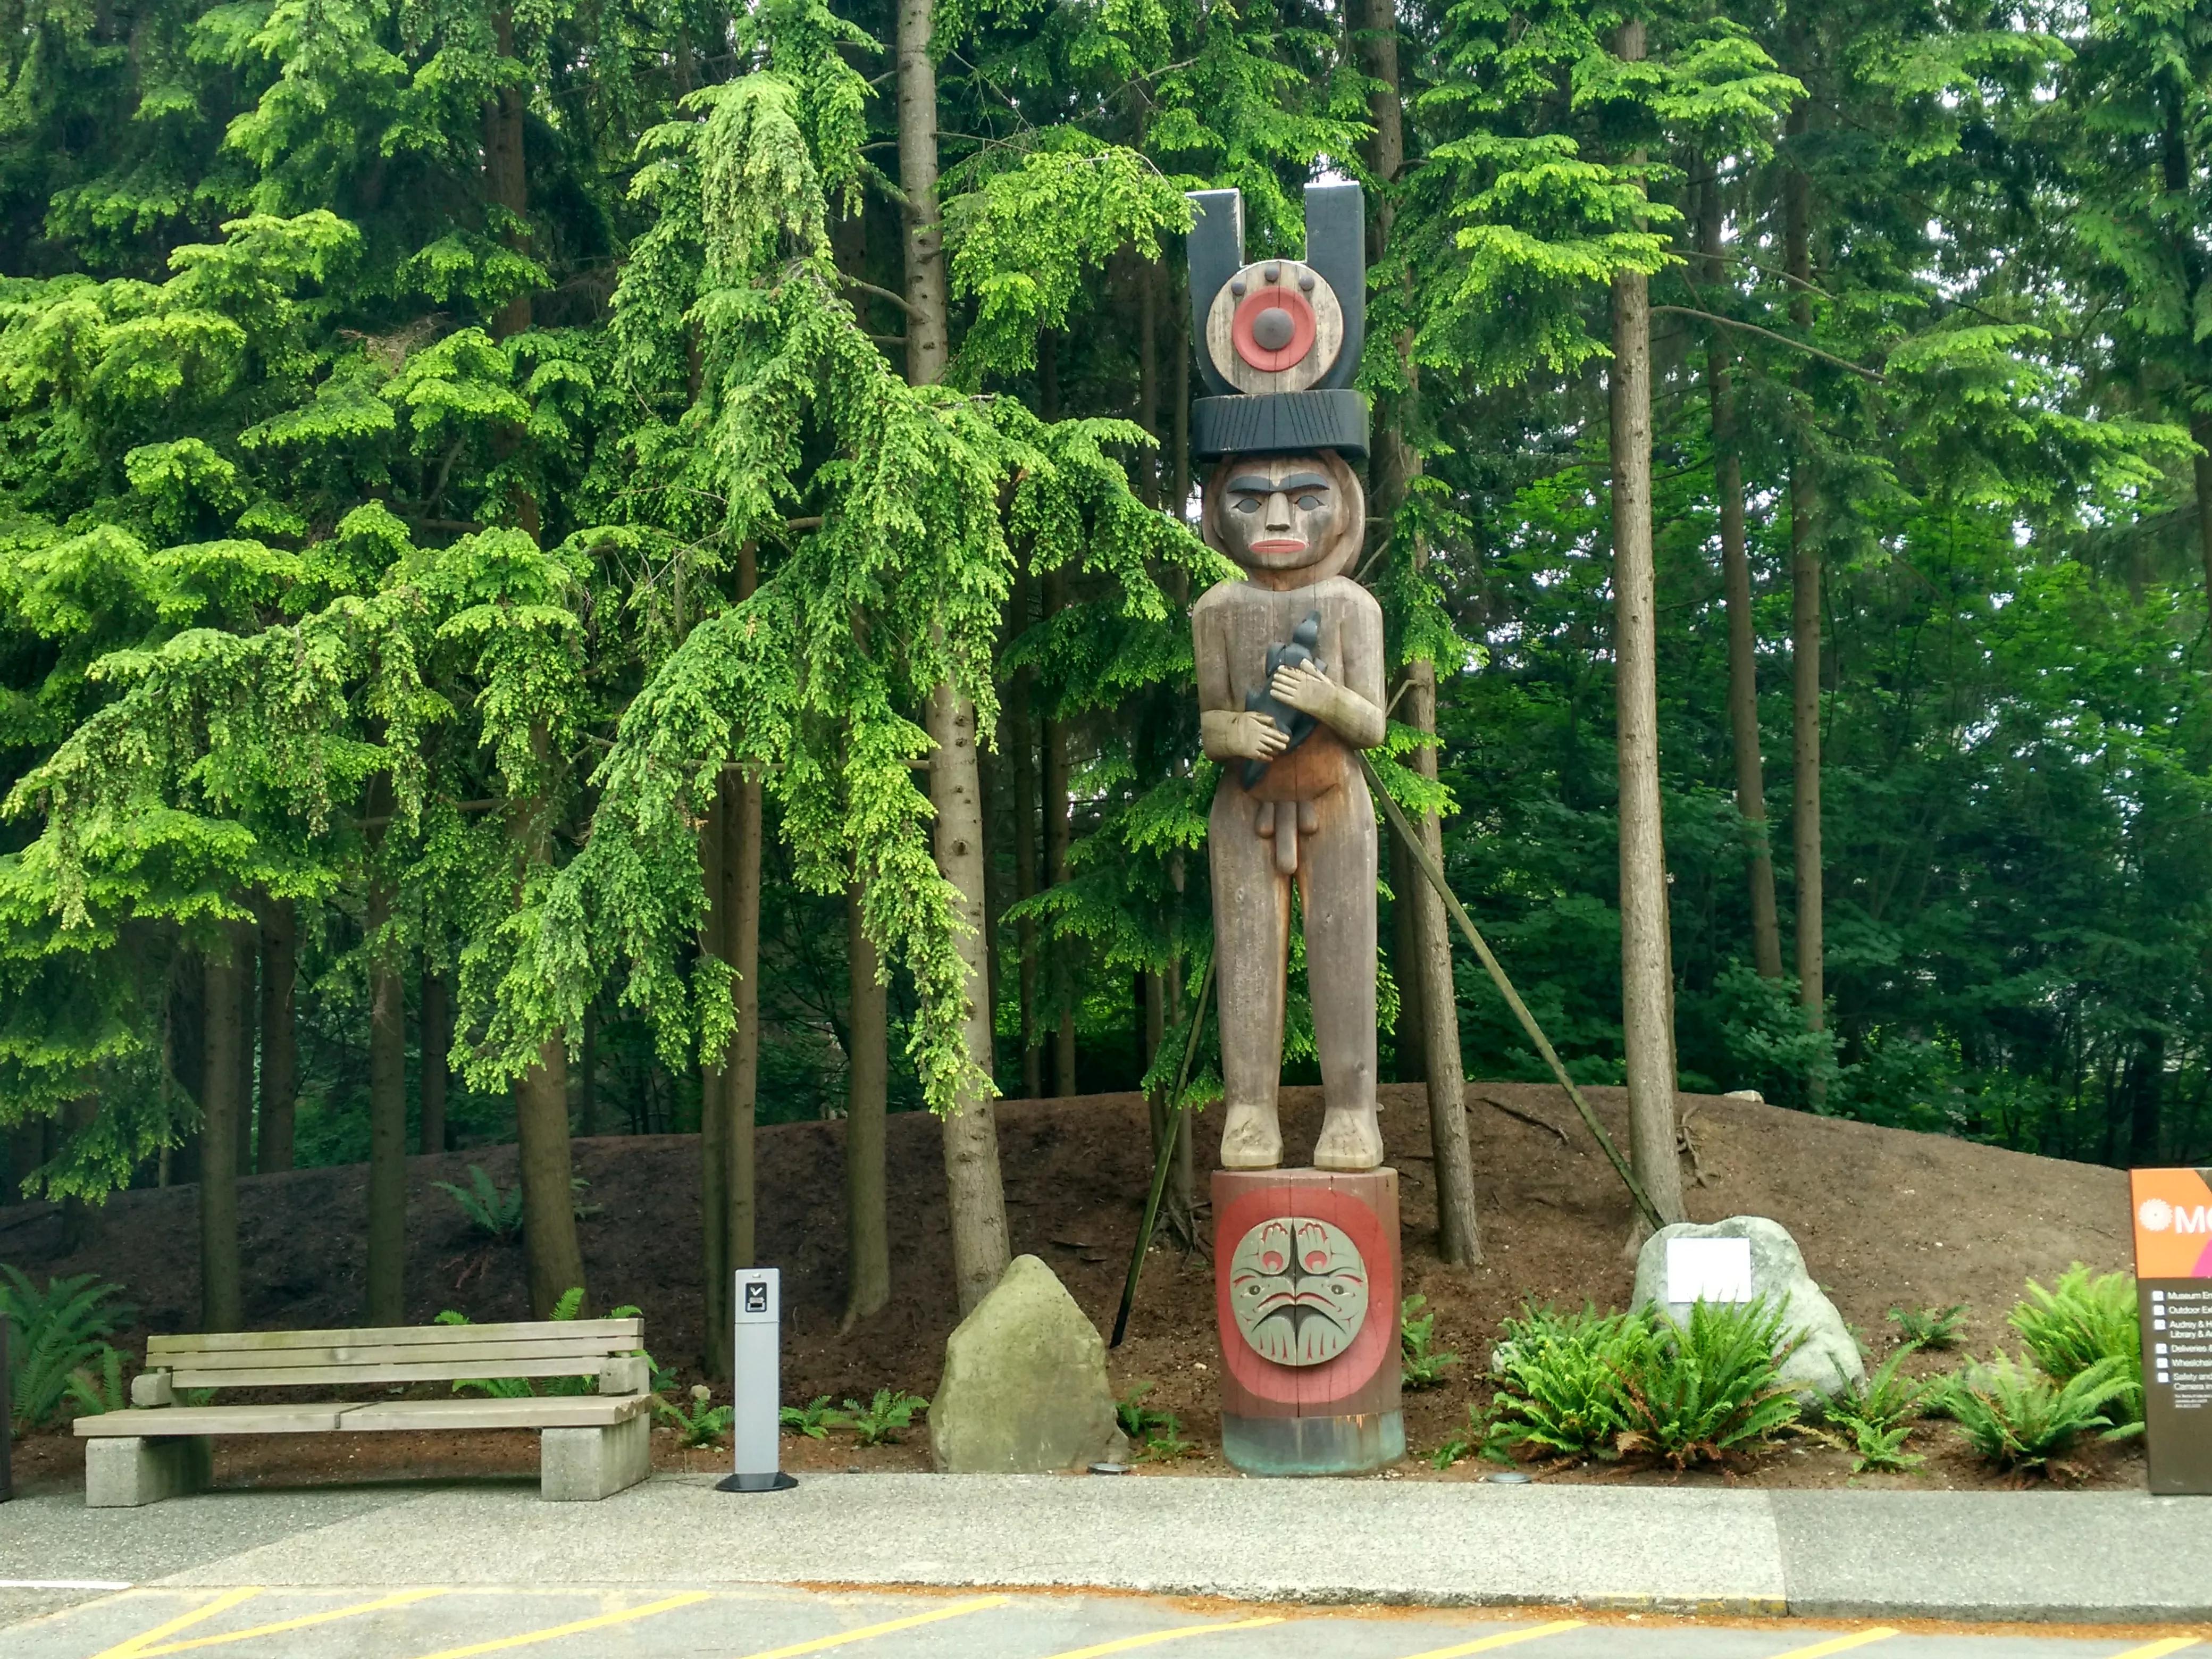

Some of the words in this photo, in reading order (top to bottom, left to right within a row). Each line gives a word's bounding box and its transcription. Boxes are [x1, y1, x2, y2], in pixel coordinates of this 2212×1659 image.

[2175, 1205, 2212, 1234] M
[2169, 1306, 2200, 1314] Outdoor
[2202, 1306, 2212, 1314] Ex
[2171, 1330, 2196, 1339] Library
[2198, 1330, 2204, 1338] &
[2172, 1344, 2207, 1353] Deliveries
[2174, 1373, 2197, 1381] Safety
